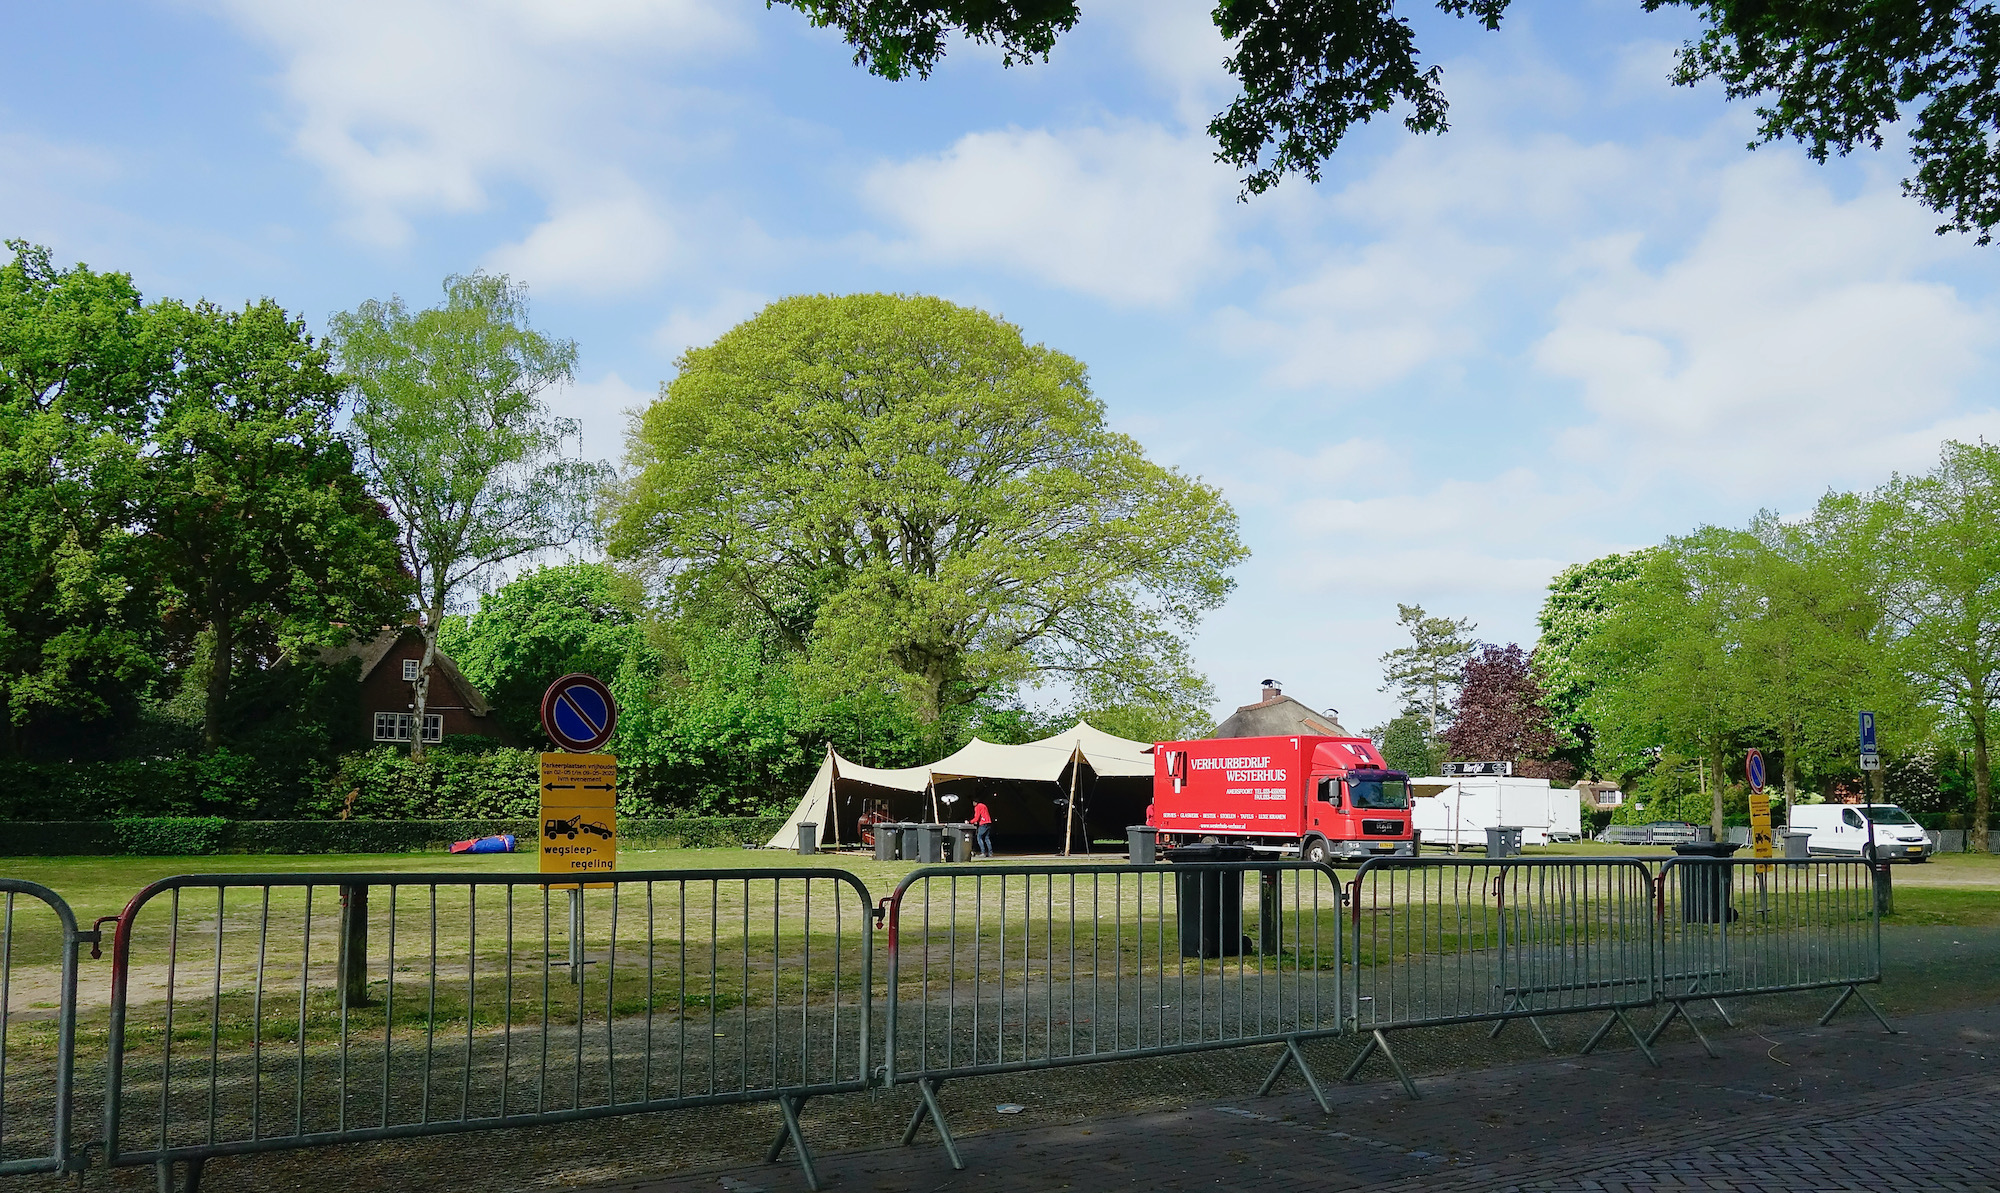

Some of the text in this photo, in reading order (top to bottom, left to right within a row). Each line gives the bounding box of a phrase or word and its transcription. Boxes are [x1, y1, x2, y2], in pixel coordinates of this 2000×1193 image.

[1863, 714, 1872, 736] P
[1190, 756, 1271, 770] VERHUURBEDRIJF
[1463, 763, 1485, 774] Biertje?
[1226, 769, 1287, 781] WESTERHUIS
[544, 845, 597, 856] wegsleep-
[571, 859, 613, 870] regeling
